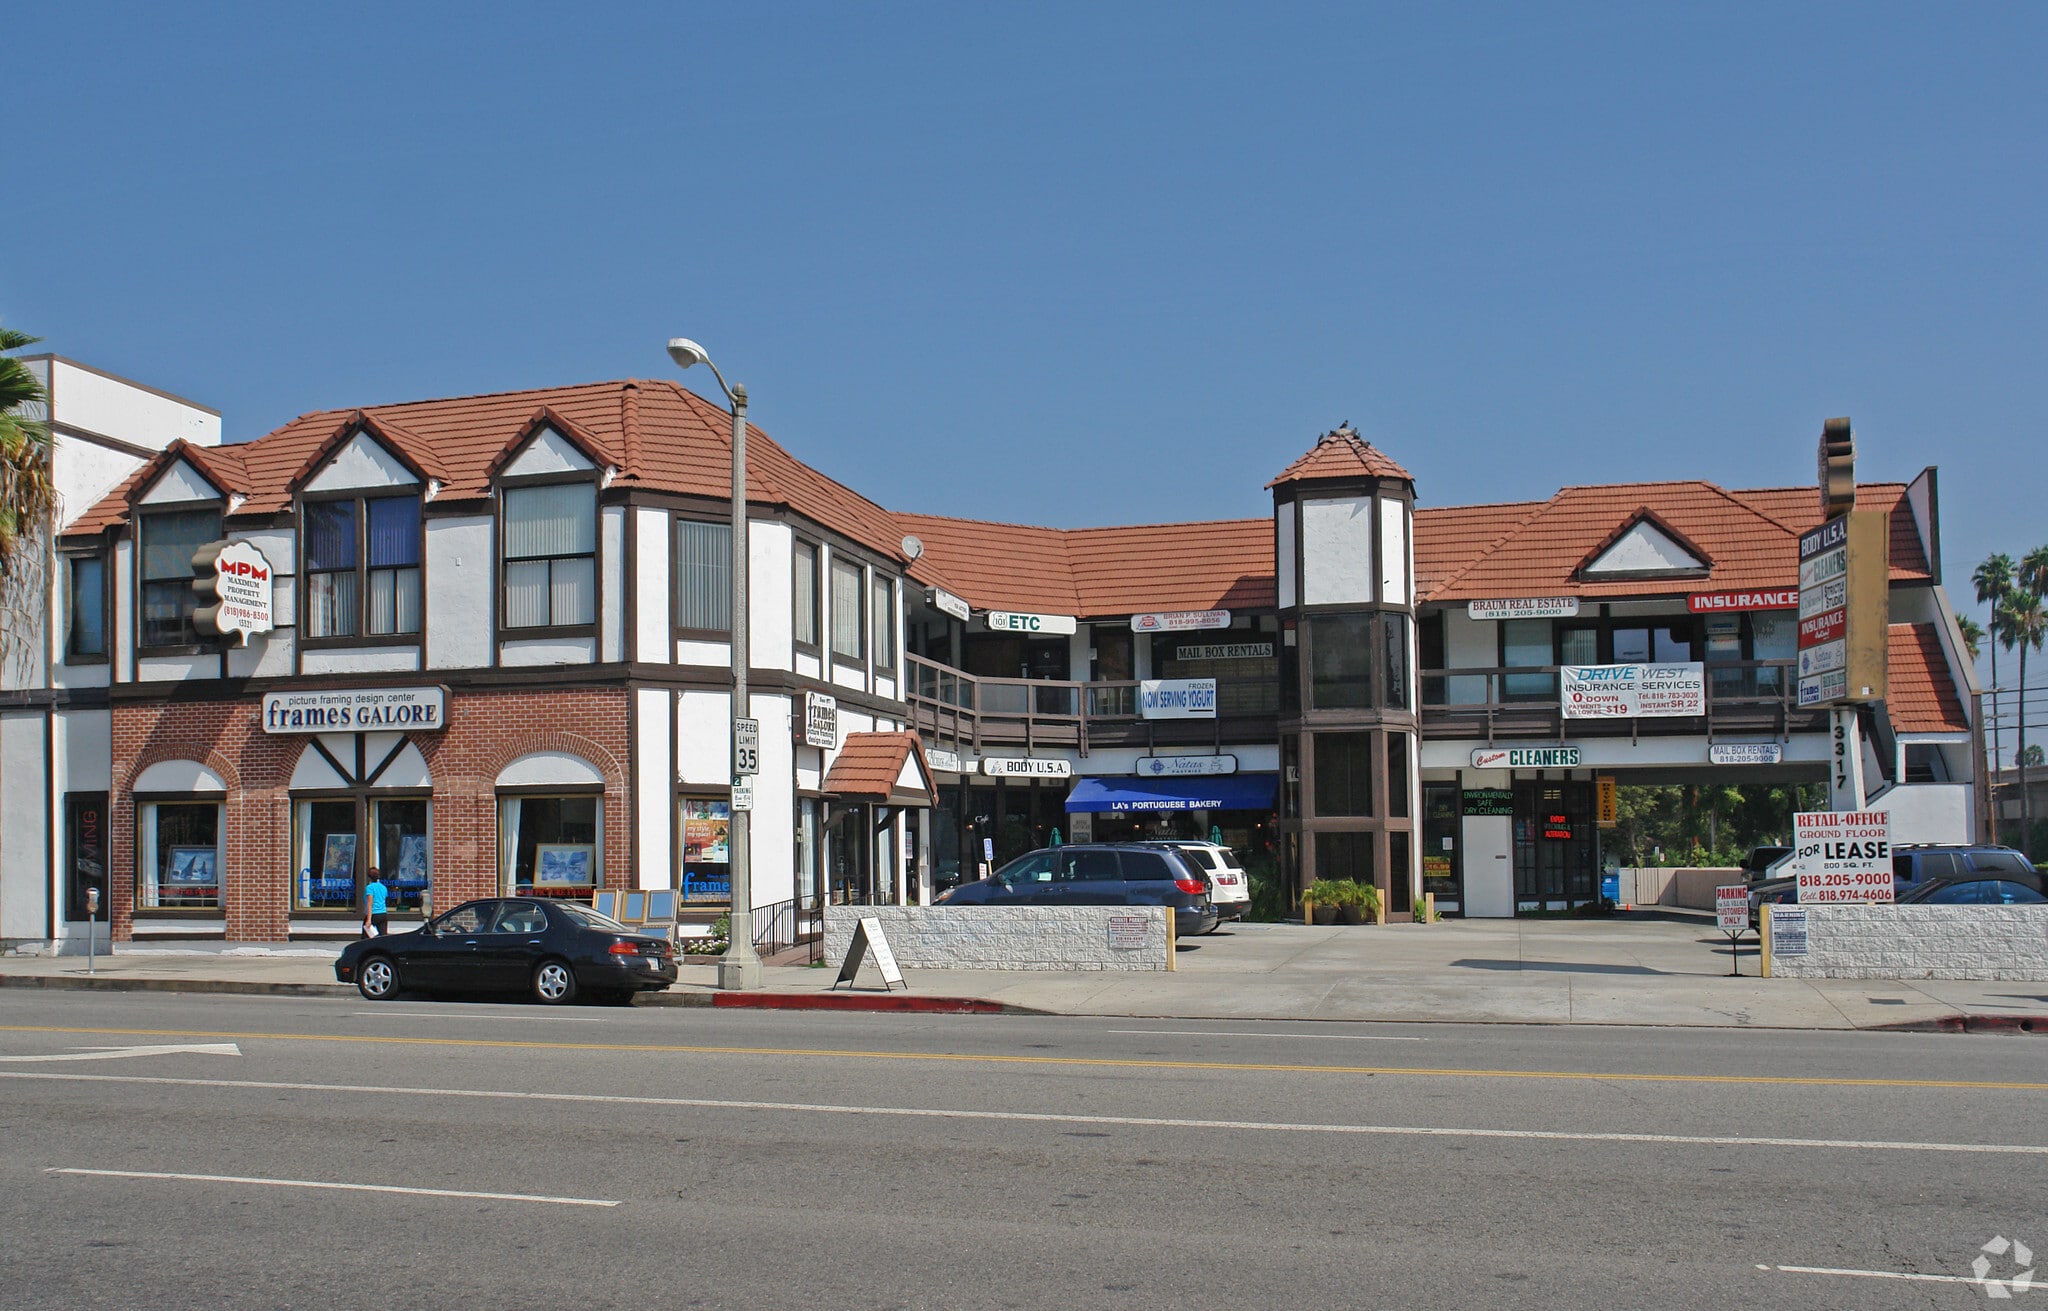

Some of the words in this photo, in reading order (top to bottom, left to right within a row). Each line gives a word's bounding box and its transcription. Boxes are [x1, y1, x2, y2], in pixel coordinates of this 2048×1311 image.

[1801, 532, 1821, 557] BODY
[1824, 522, 1847, 547] U.S.A.
[221, 558, 267, 581] MPM
[1813, 550, 1846, 582] CLEANERS
[228, 576, 260, 589] MAXIMUM
[227, 585, 260, 598] PROPERTY
[1825, 582, 1844, 598] STRICTLY
[224, 594, 267, 609] MANAGEMENT
[1473, 601, 1506, 610] BRAUM
[1509, 599, 1535, 609] REAL
[1537, 597, 1574, 608] ESTATE
[1694, 592, 1799, 609] INSURANCE
[1826, 593, 1844, 609] STUDIO
[1163, 612, 1185, 620] BRIAN
[1193, 610, 1227, 618] SULLIVAN
[1485, 610, 1511, 618] (818)
[995, 616, 1006, 626] 101
[1009, 615, 1041, 631] ETC
[1802, 611, 1843, 635] INSURANCE
[1178, 647, 1202, 659] MAIL
[1205, 646, 1226, 658] BOX
[1227, 644, 1271, 657] RENTALS
[1577, 667, 1638, 680] DRIVE
[1641, 667, 1688, 679] WEST
[1565, 682, 1635, 692] INSURANCE
[1641, 681, 1701, 690] SERVICES
[289, 696, 317, 707] picture
[320, 694, 351, 705] framing
[355, 693, 384, 705] design
[387, 692, 415, 702] center
[1142, 691, 1158, 708] NOW
[1160, 690, 1187, 708] SERVING
[1188, 690, 1215, 707] YOGURT
[1586, 695, 1619, 703] DOWN
[1670, 700, 1685, 708] SR
[268, 699, 351, 727] frames
[356, 704, 437, 725] GALORE
[808, 693, 836, 728] frames
[1606, 704, 1628, 714] $19
[736, 722, 757, 733] SPEED
[738, 735, 756, 745] LIMIT
[1714, 745, 1730, 754] MAIL
[1731, 745, 1746, 754] BOX
[1747, 745, 1779, 754] RENTALS
[738, 748, 757, 770] 35
[1476, 751, 1506, 766] Custom
[1509, 749, 1579, 766] CLEANERS
[1006, 761, 1034, 774] BODY
[1037, 762, 1067, 774] U.S.A.
[733, 787, 752, 795] PARKING
[1463, 791, 1513, 799] ENVIRONMENTALLY
[1112, 801, 1129, 810] LA's
[1132, 801, 1186, 809] PORTUGUESE
[1189, 800, 1222, 808] BAKERY
[1797, 811, 1888, 827] RETAIL-OFFICE
[1799, 830, 1841, 839] GROUND
[1845, 828, 1886, 838] FLOOR
[1798, 843, 1820, 859] FOR
[1824, 841, 1888, 859] LEASE
[298, 867, 355, 899] frames
[683, 872, 731, 900] frame
[1799, 872, 1891, 887] 818.205-9000
[312, 891, 354, 900] GALORE
[1717, 887, 1747, 900] PARKING
[1818, 889, 1892, 901] 818.974-4606
[1717, 907, 1747, 916] CUSTOMERS
[1724, 916, 1741, 925] ONLY
